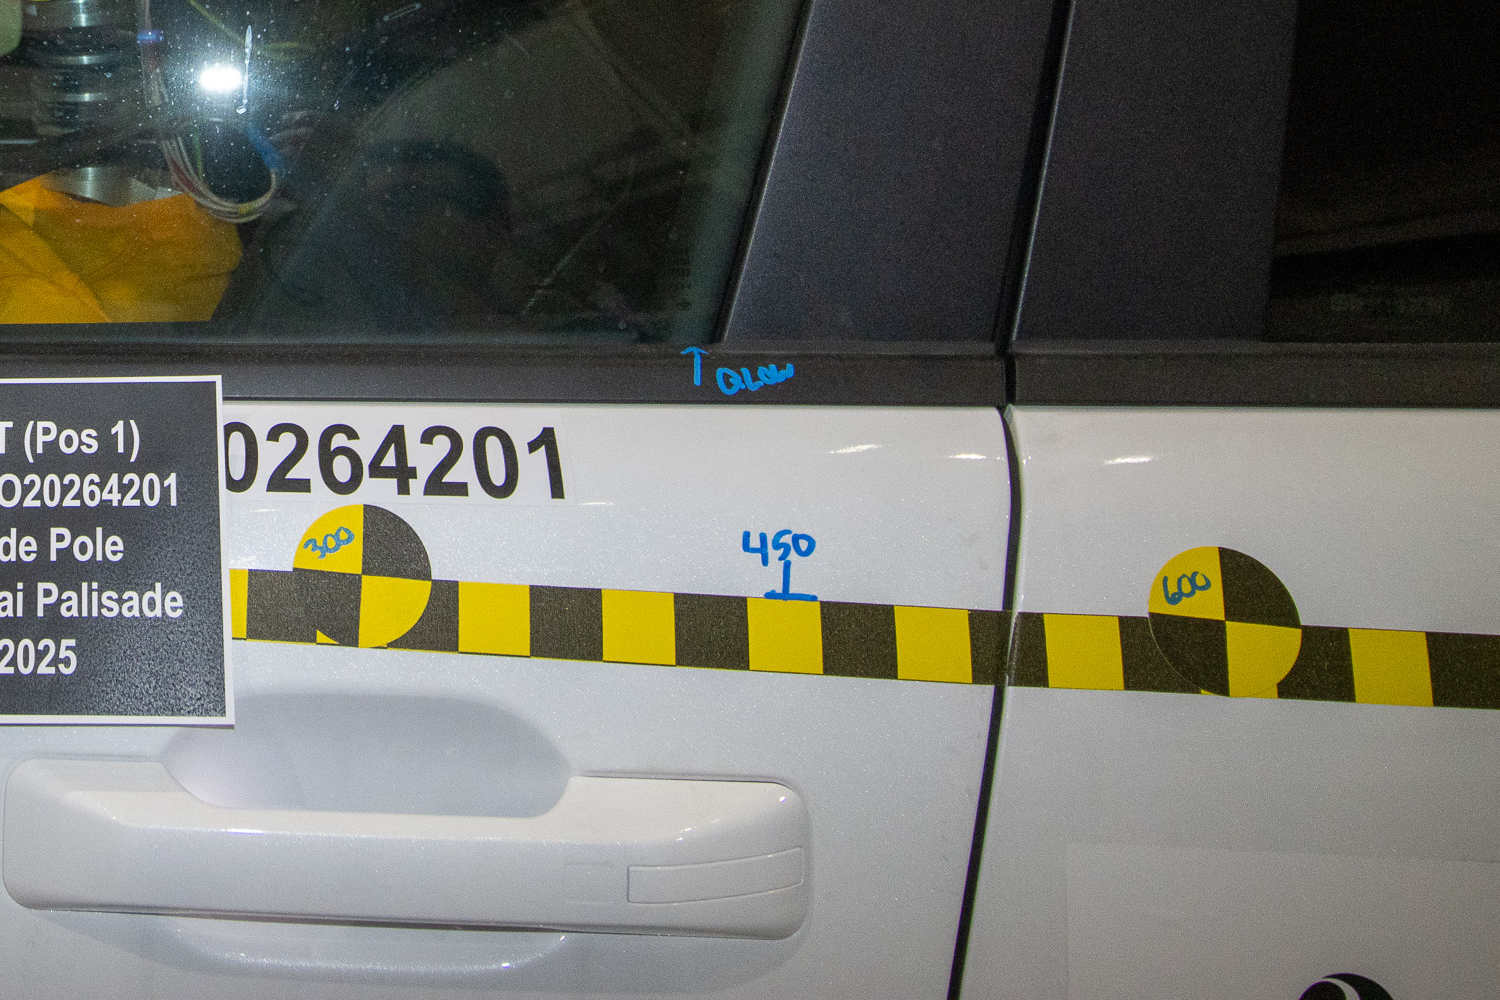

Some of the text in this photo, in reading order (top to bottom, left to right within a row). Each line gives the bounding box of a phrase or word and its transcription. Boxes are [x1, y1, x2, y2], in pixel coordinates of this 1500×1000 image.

[24, 420, 99, 463] (Pos
[110, 419, 140, 462] 1)
[49, 526, 125, 562] Pole
[303, 525, 356, 560] 300
[741, 529, 817, 567] 450
[36, 581, 184, 618] Palisade
[1162, 570, 1212, 606] 600
